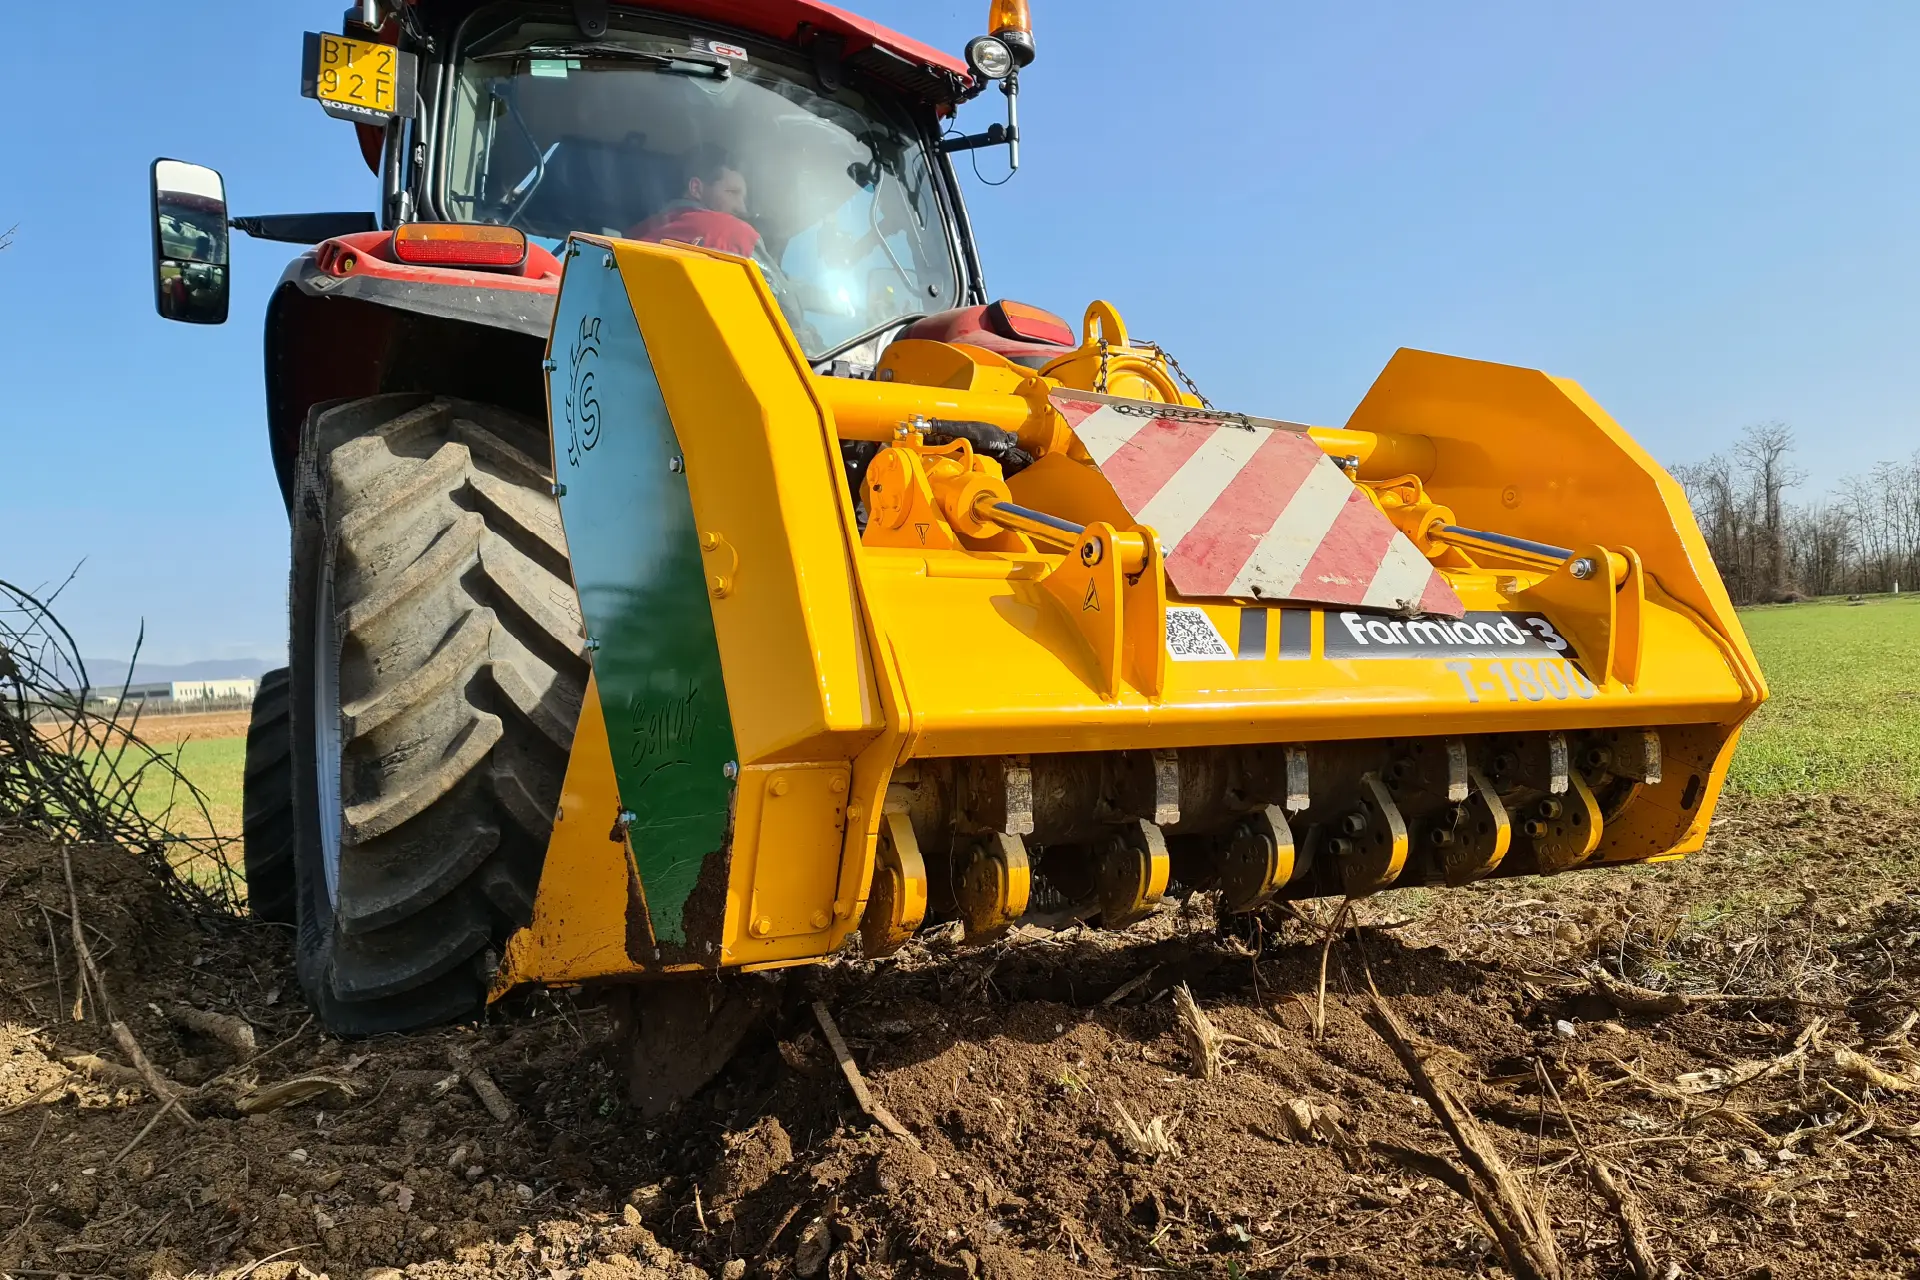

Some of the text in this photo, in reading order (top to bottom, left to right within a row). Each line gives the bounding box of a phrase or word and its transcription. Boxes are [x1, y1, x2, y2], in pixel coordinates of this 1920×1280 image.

[323, 39, 357, 68] BT
[321, 99, 374, 116] SOFIM
[1444, 660, 1595, 704] T-1800
